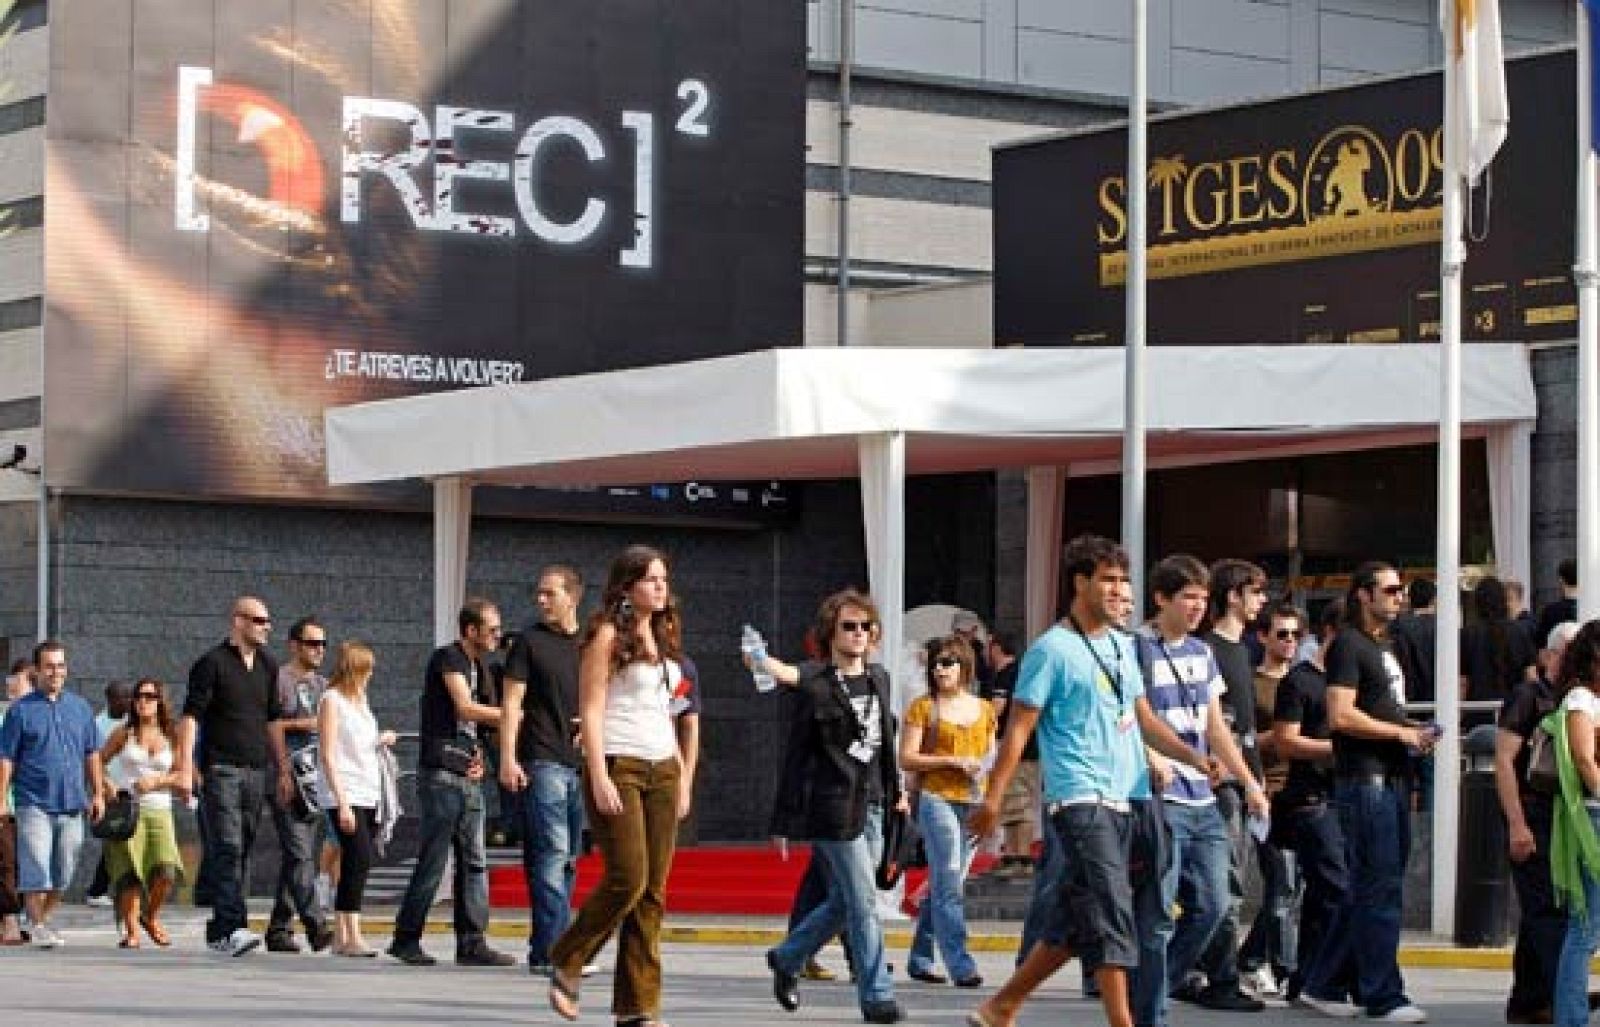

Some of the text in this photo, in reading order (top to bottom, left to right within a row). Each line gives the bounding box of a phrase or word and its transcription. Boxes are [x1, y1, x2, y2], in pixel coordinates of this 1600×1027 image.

[1097, 149, 1299, 242] STGES
[357, 351, 431, 381] ATREVES
[435, 357, 449, 382] A
[450, 358, 525, 386] VOLVER?
